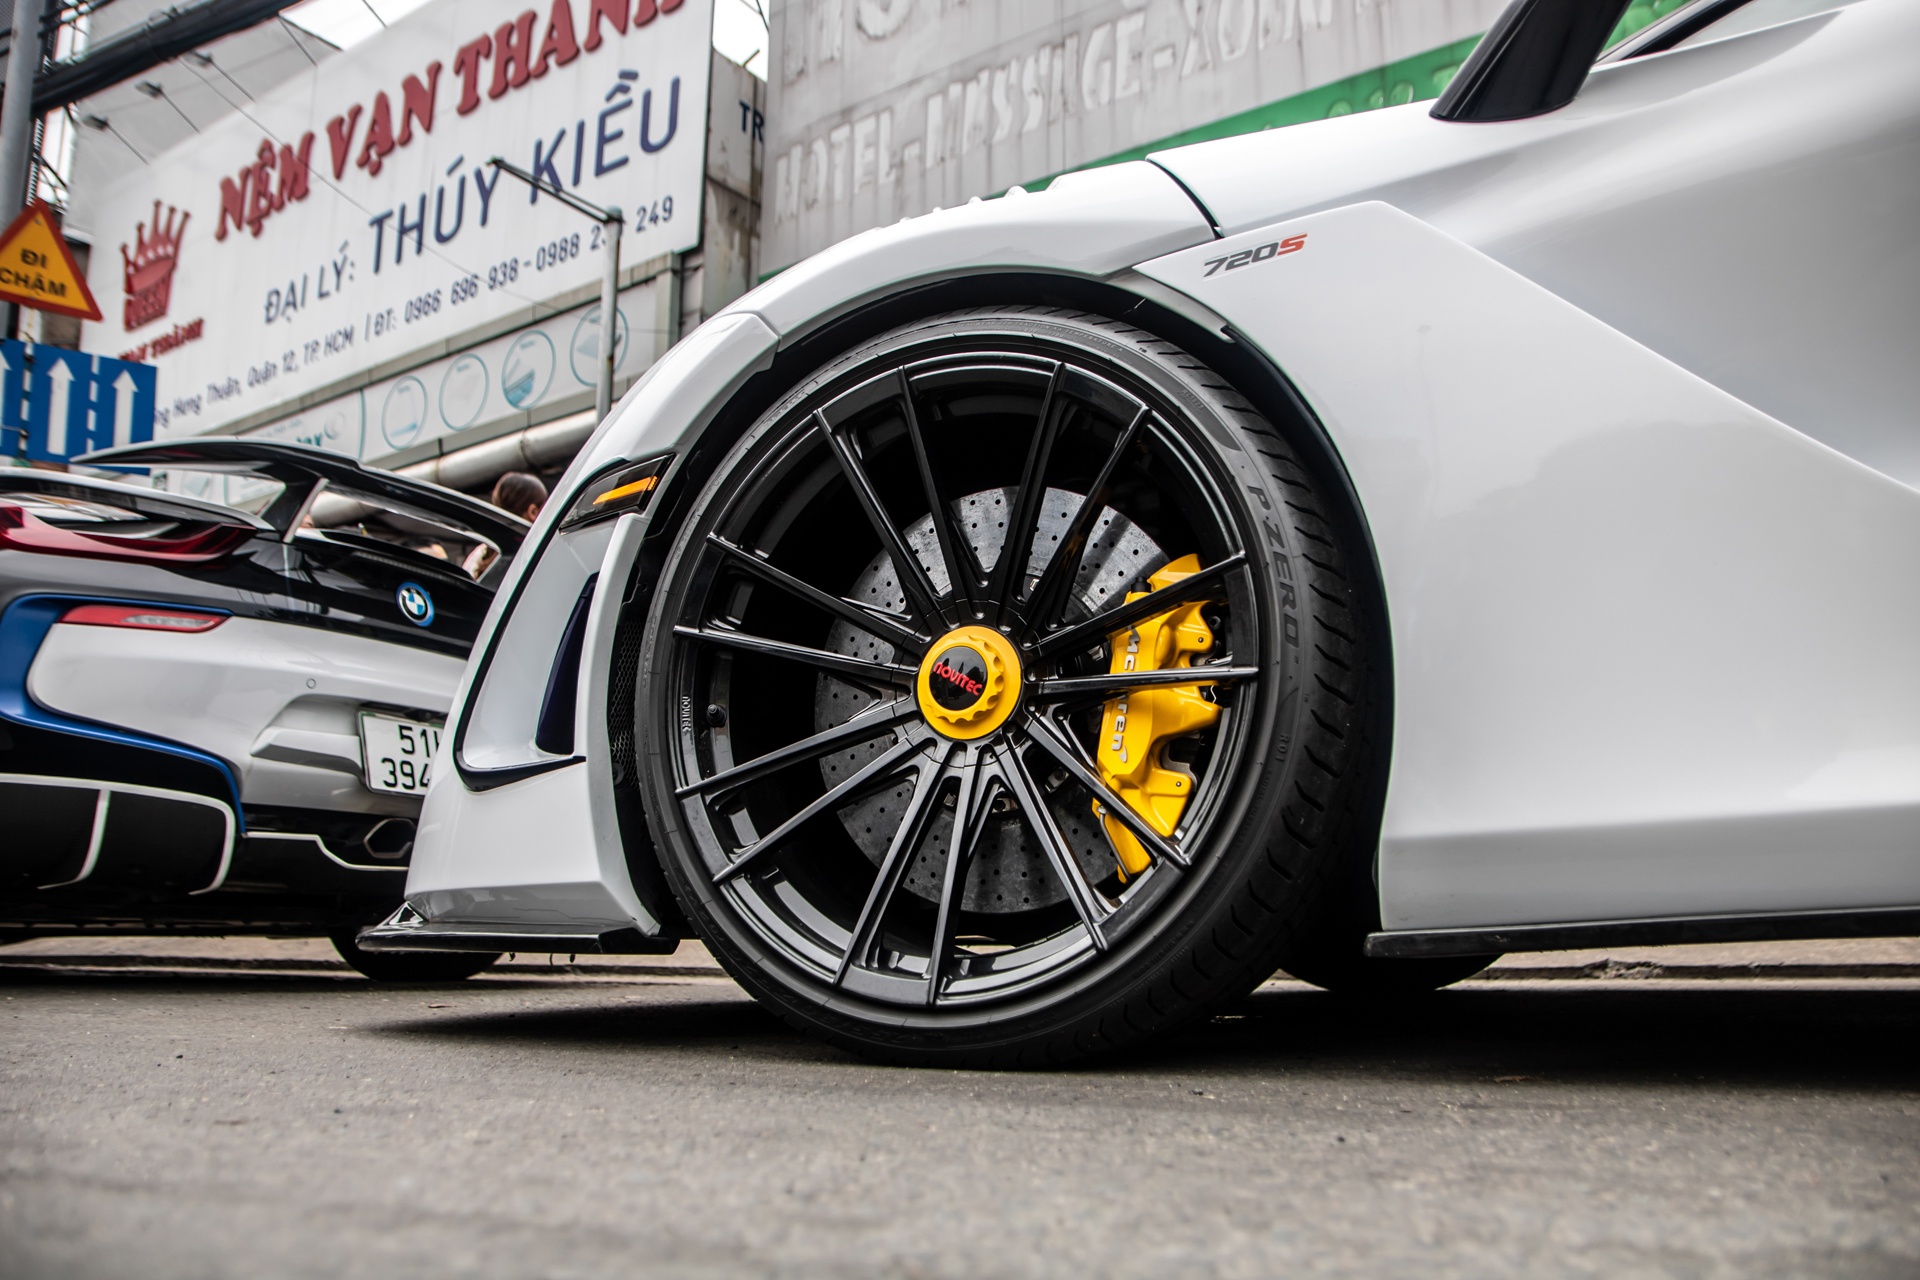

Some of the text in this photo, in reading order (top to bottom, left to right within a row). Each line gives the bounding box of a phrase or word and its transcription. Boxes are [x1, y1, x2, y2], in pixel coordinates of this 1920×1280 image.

[214, 131, 316, 242] NỆM
[325, 61, 442, 181] VẠN
[263, 69, 681, 324] ĐẠI LÝ: THÚY KIỀU
[21, 248, 47, 269] ĐI
[324, 324, 355, 357] HCM
[404, 290, 441, 325] 0966
[449, 273, 479, 306] 696
[488, 257, 519, 291] 938
[536, 233, 581, 272] 0988
[635, 195, 674, 233] 249
[1203, 233, 1308, 278] 720S
[1247, 485, 1300, 649] P ZERO
[933, 661, 983, 697] NOVITEC
[1112, 624, 1140, 751] Mcren
